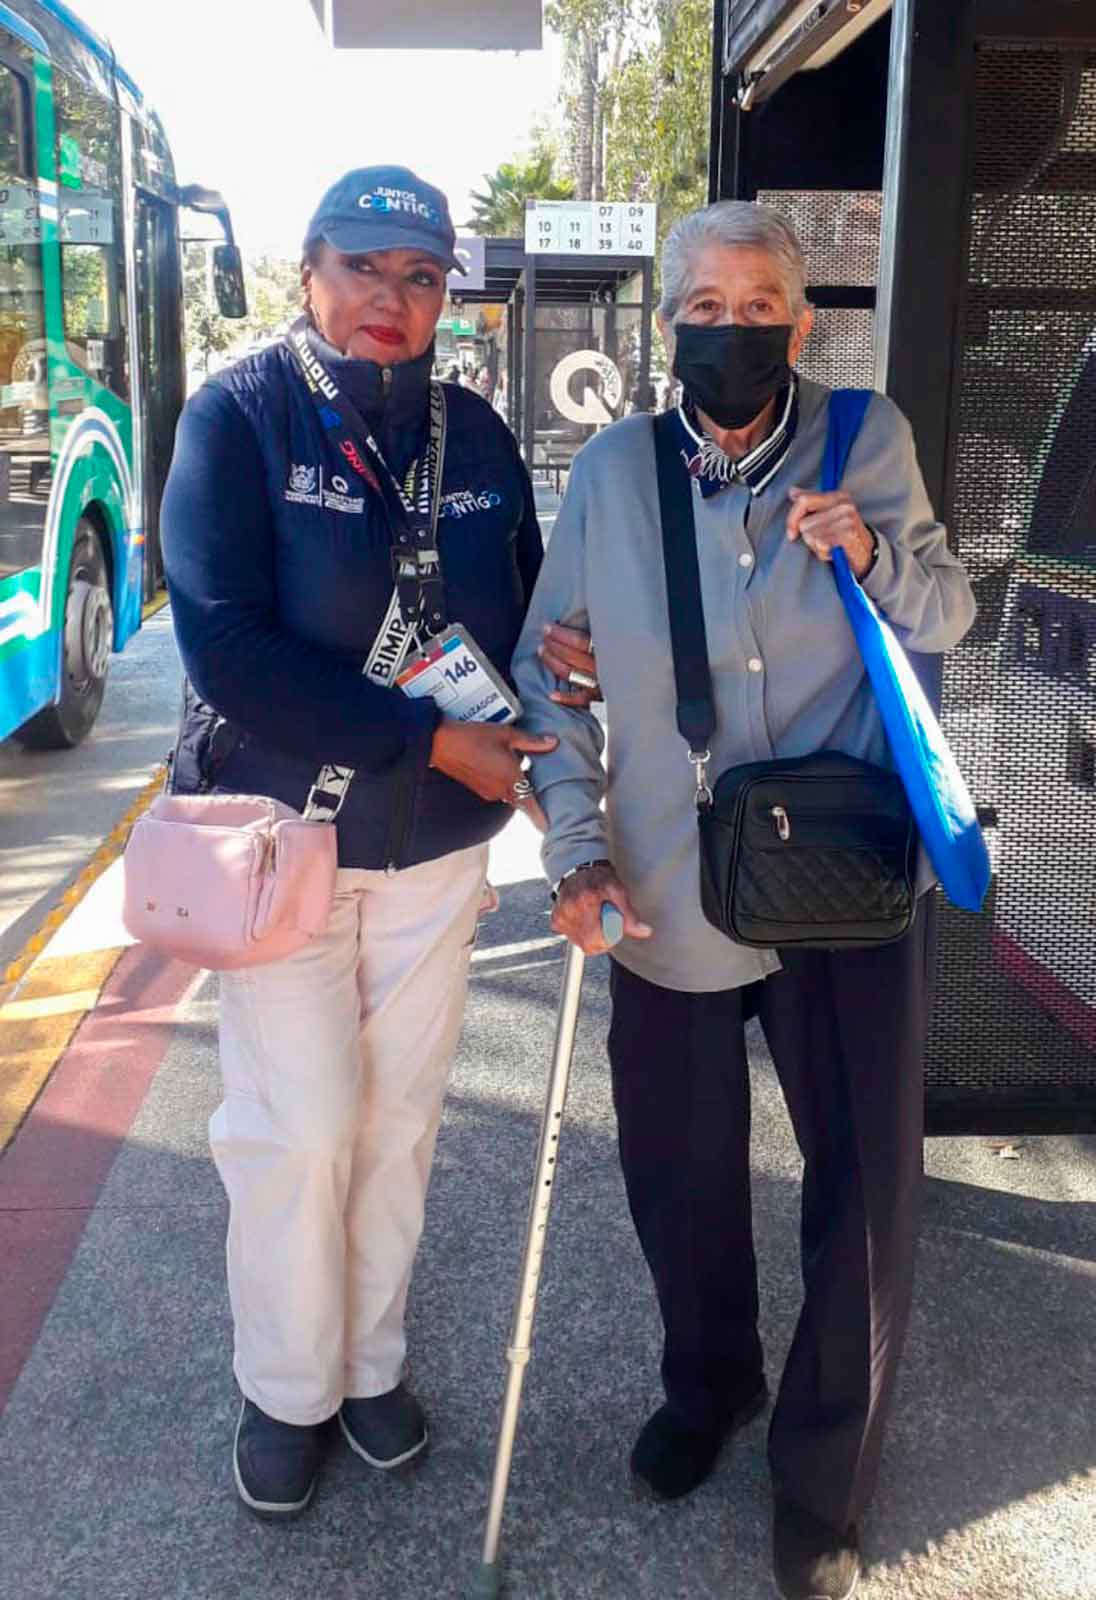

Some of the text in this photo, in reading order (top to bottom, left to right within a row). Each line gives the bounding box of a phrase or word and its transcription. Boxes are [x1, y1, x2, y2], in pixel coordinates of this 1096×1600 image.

[373, 186, 417, 200] JUNTOS
[599, 206, 613, 217] 07
[628, 206, 644, 217] 09
[538, 221, 643, 233] 10 11 13 14
[538, 238, 643, 250] 17 18 39 40
[444, 655, 478, 684] 146
